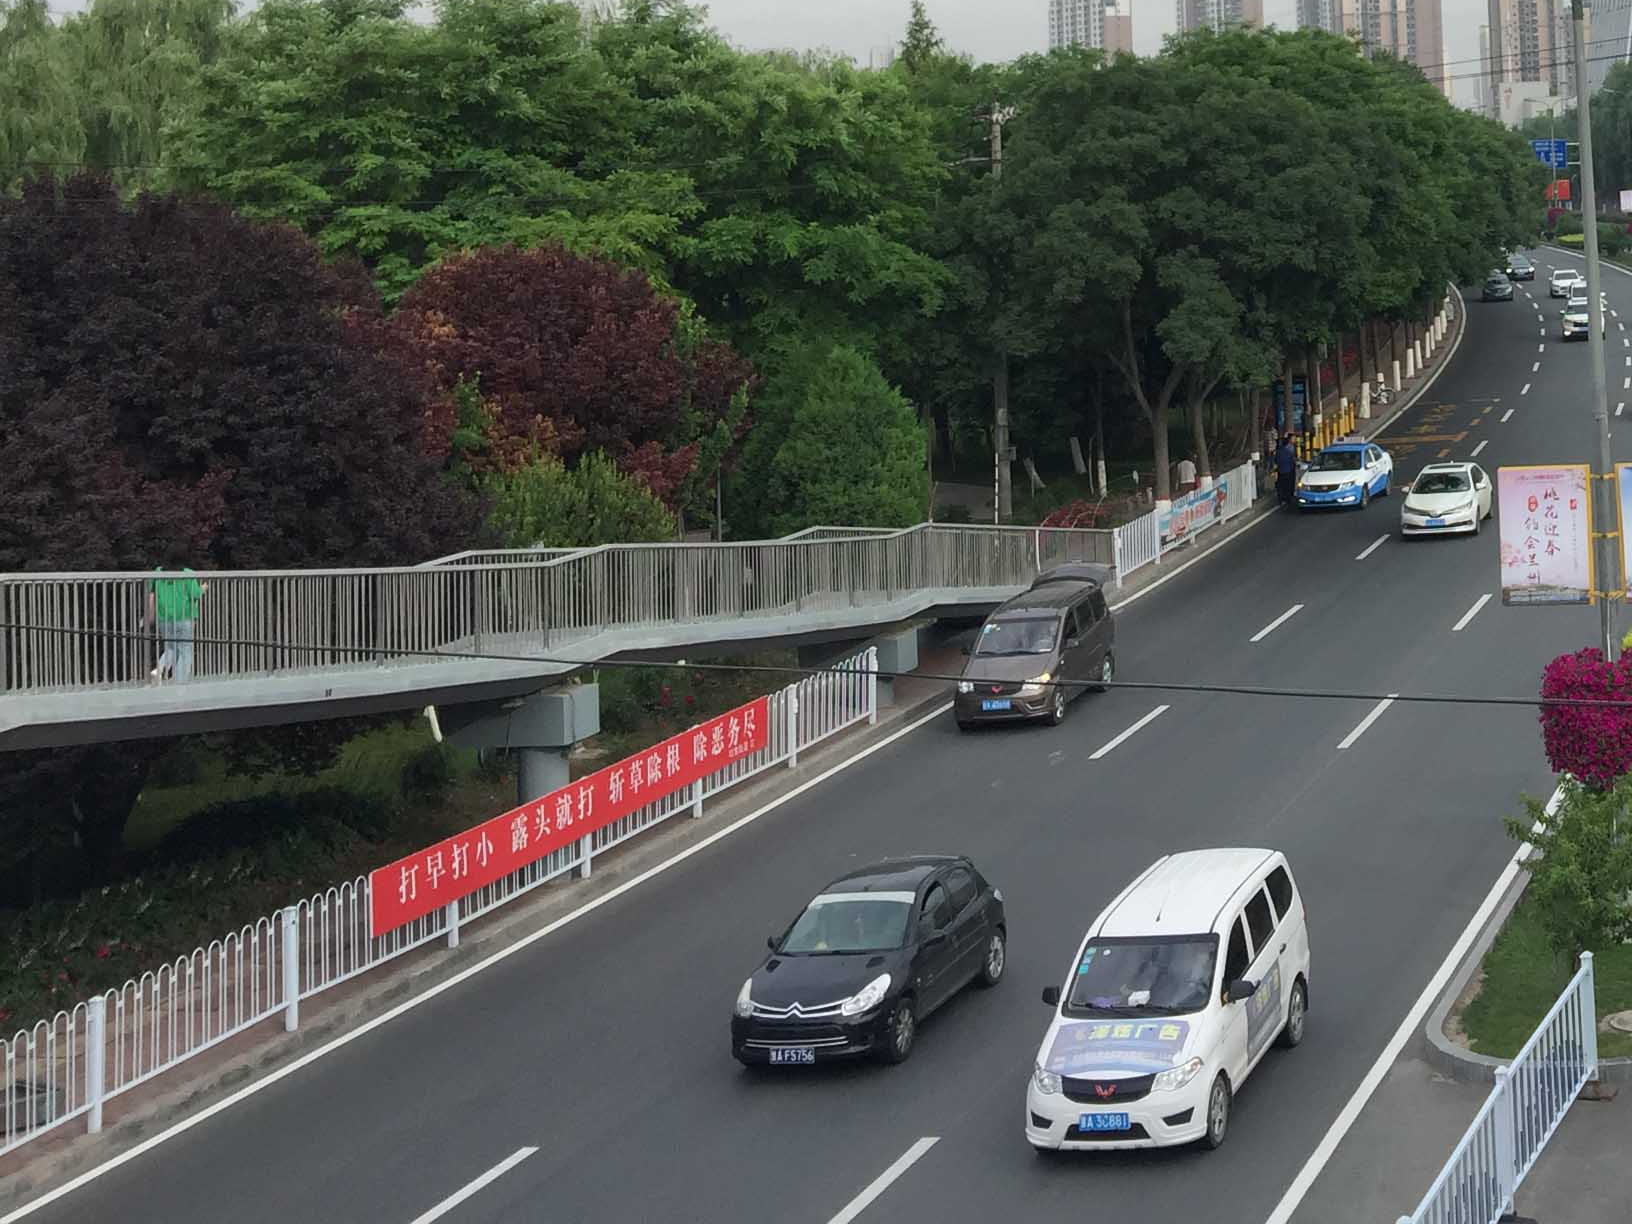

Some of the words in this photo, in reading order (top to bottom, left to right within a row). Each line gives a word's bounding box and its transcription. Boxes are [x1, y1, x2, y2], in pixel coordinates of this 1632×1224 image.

[398, 831, 494, 904] 打早打小
[511, 785, 595, 853] 露头就打
[608, 744, 681, 804] 斩草除根
[692, 708, 757, 763] 除恶务尽
